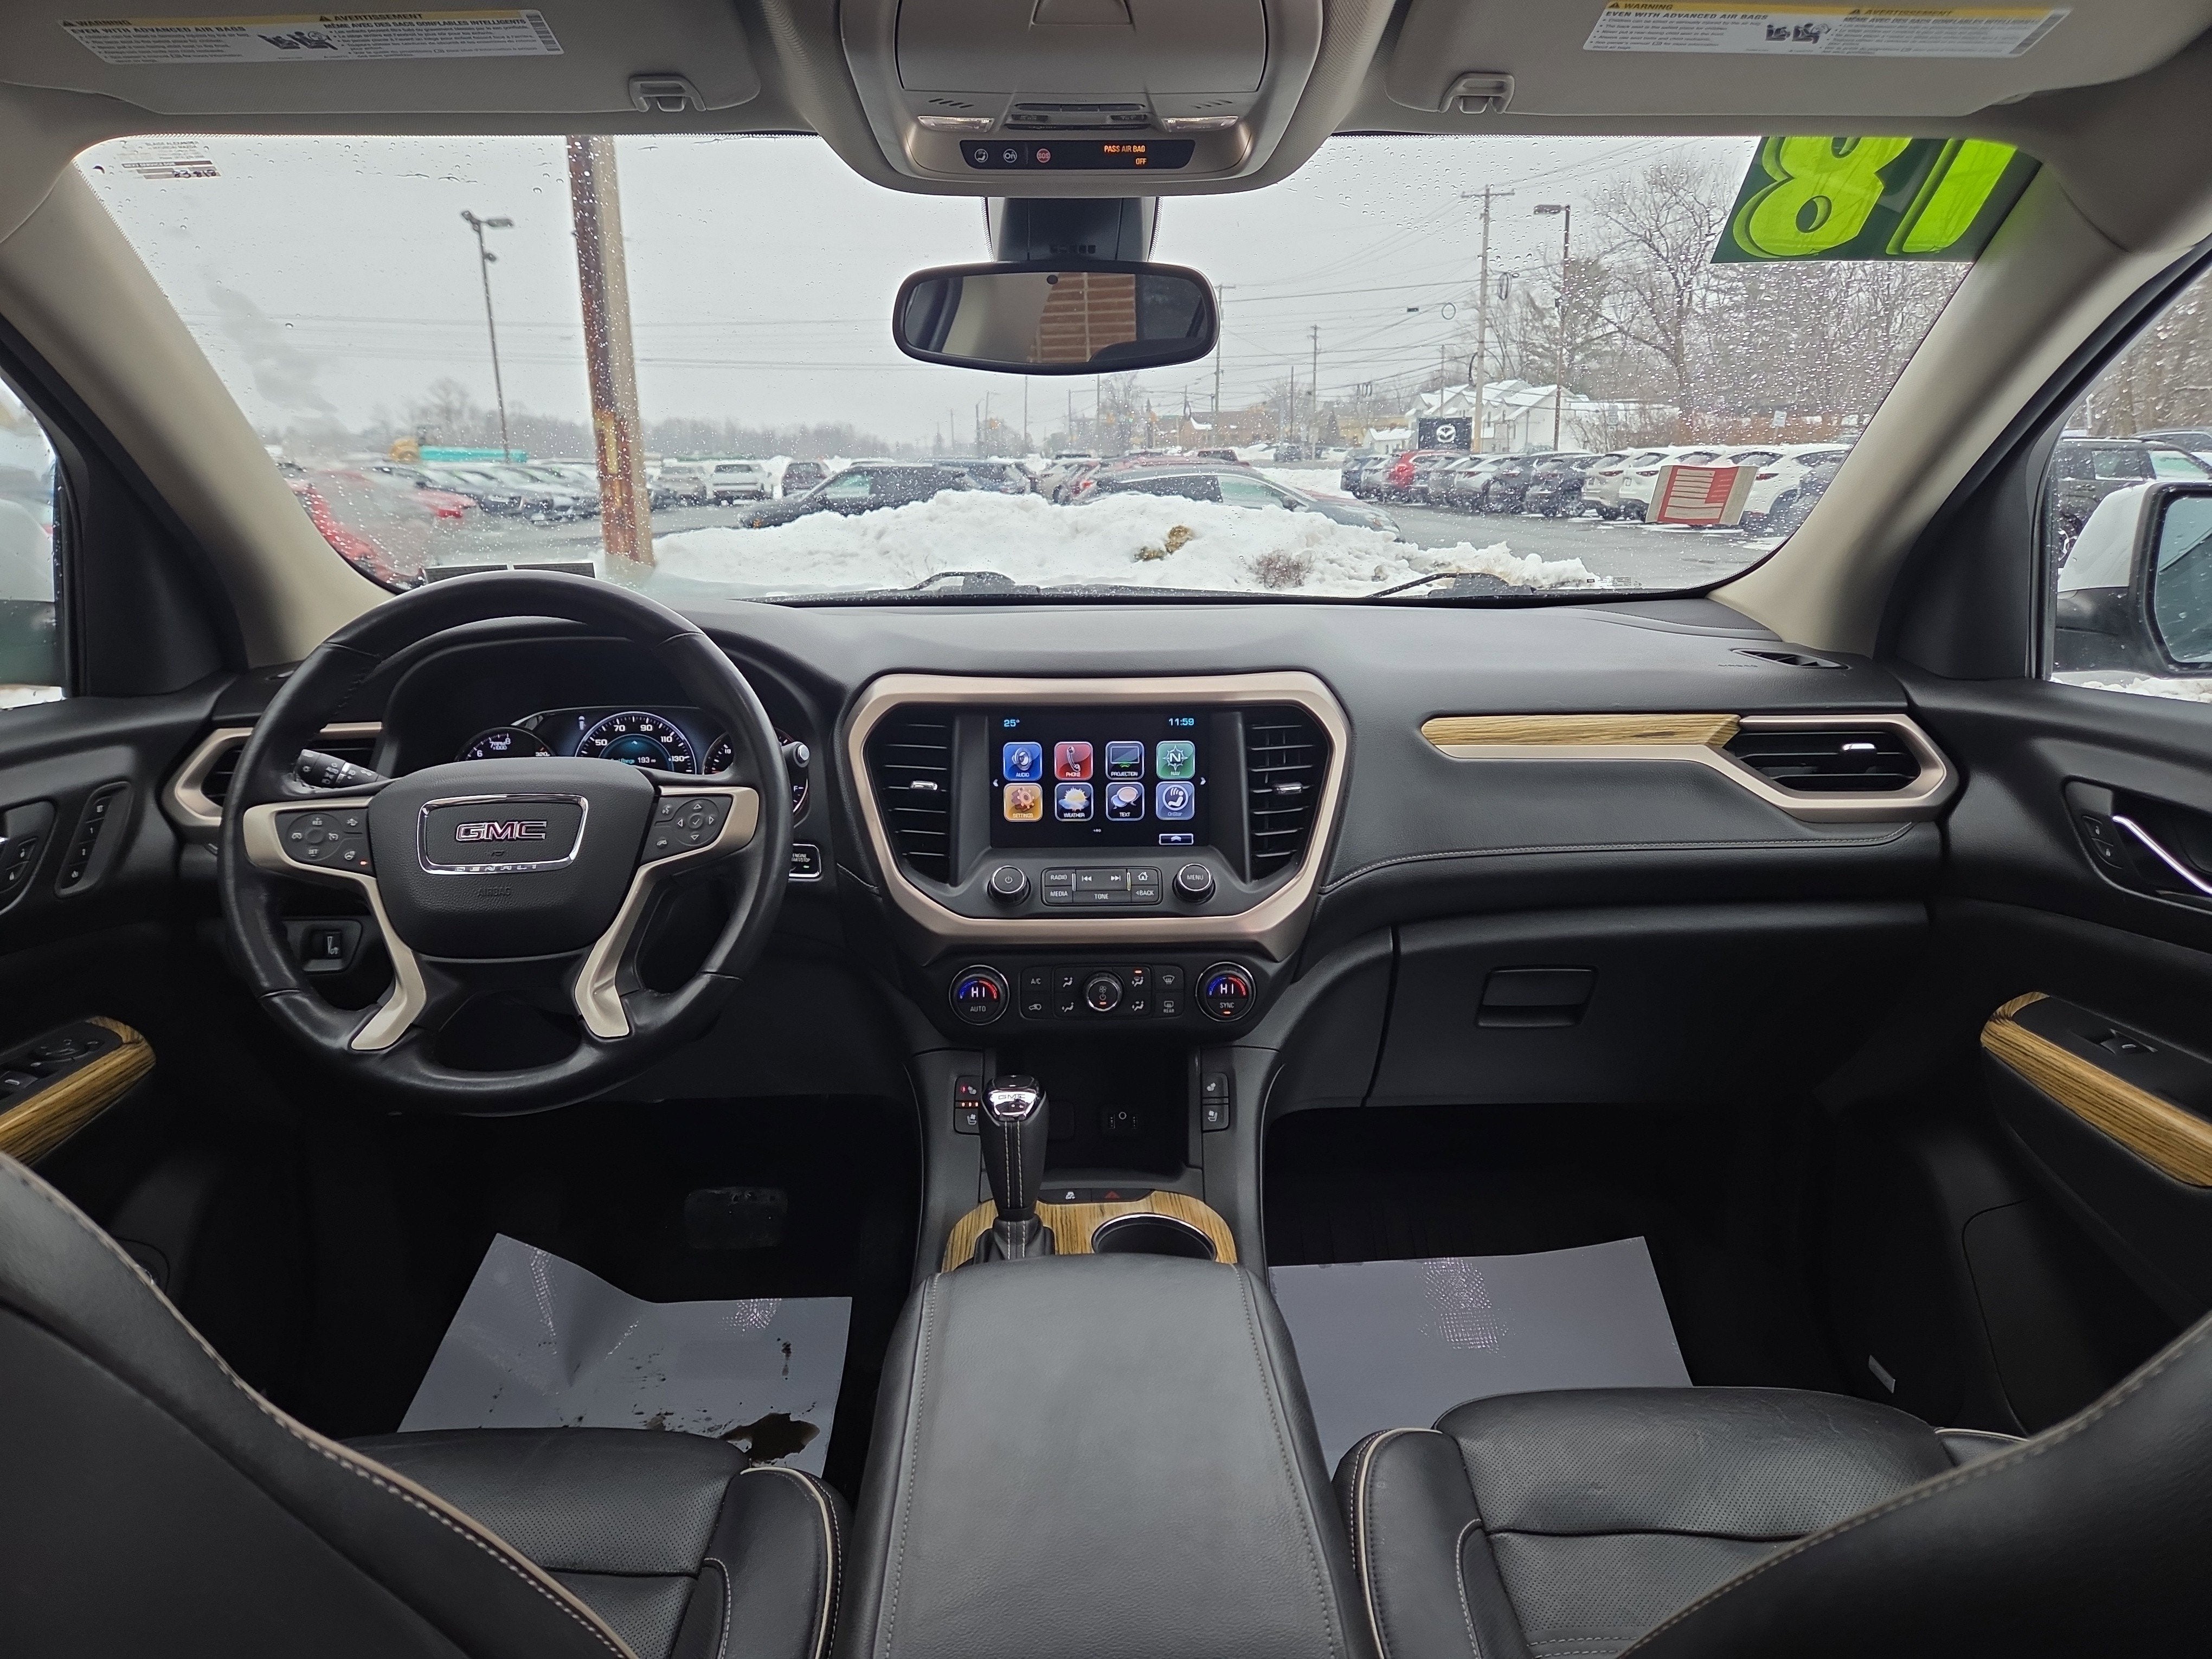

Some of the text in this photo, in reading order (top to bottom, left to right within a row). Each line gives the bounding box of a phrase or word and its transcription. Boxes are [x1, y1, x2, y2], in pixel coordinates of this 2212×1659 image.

[1168, 718, 1194, 727] 11:59
[455, 820, 548, 841] GMC
[1050, 890, 1068, 898] MEDIA
[1031, 977, 1041, 985] A/C
[970, 986, 986, 998] HI
[1220, 983, 1234, 994] HI
[970, 1005, 986, 1013] AUTO
[1219, 1001, 1235, 1009] SYNC
